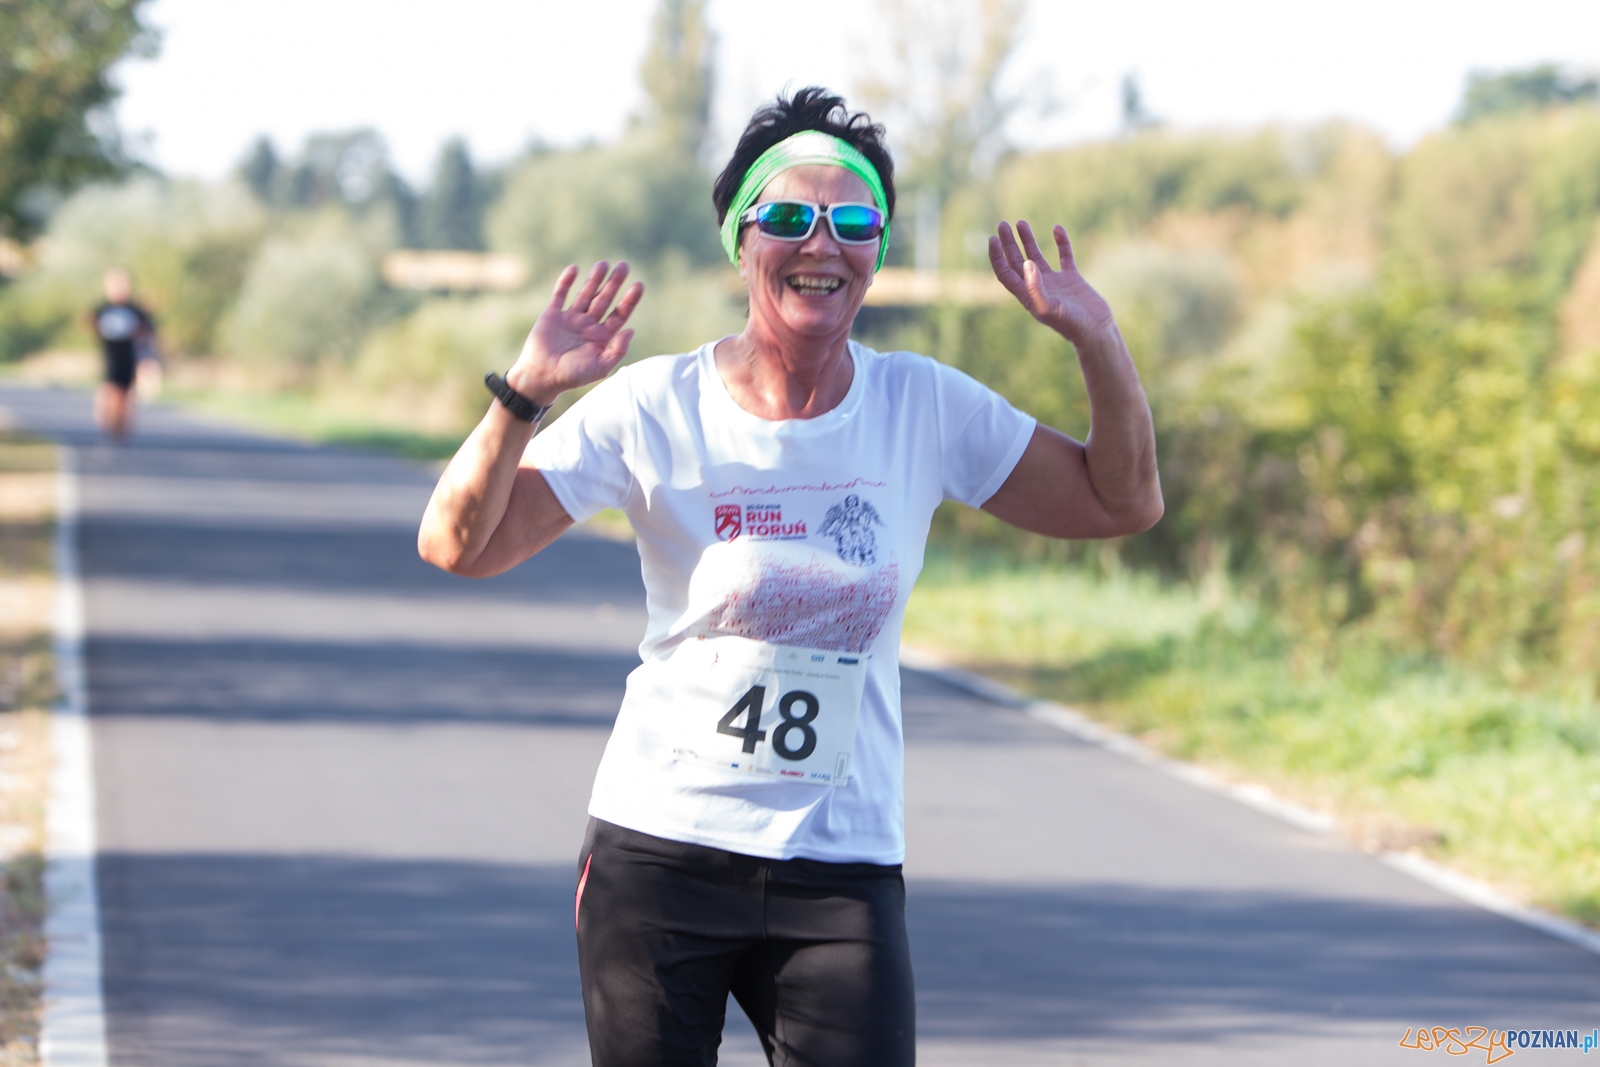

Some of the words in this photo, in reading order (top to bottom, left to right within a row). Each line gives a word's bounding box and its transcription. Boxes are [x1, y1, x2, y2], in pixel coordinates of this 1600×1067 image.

[746, 511, 782, 523] RUN
[746, 519, 807, 536] TORUŃ
[716, 684, 820, 761] 48
